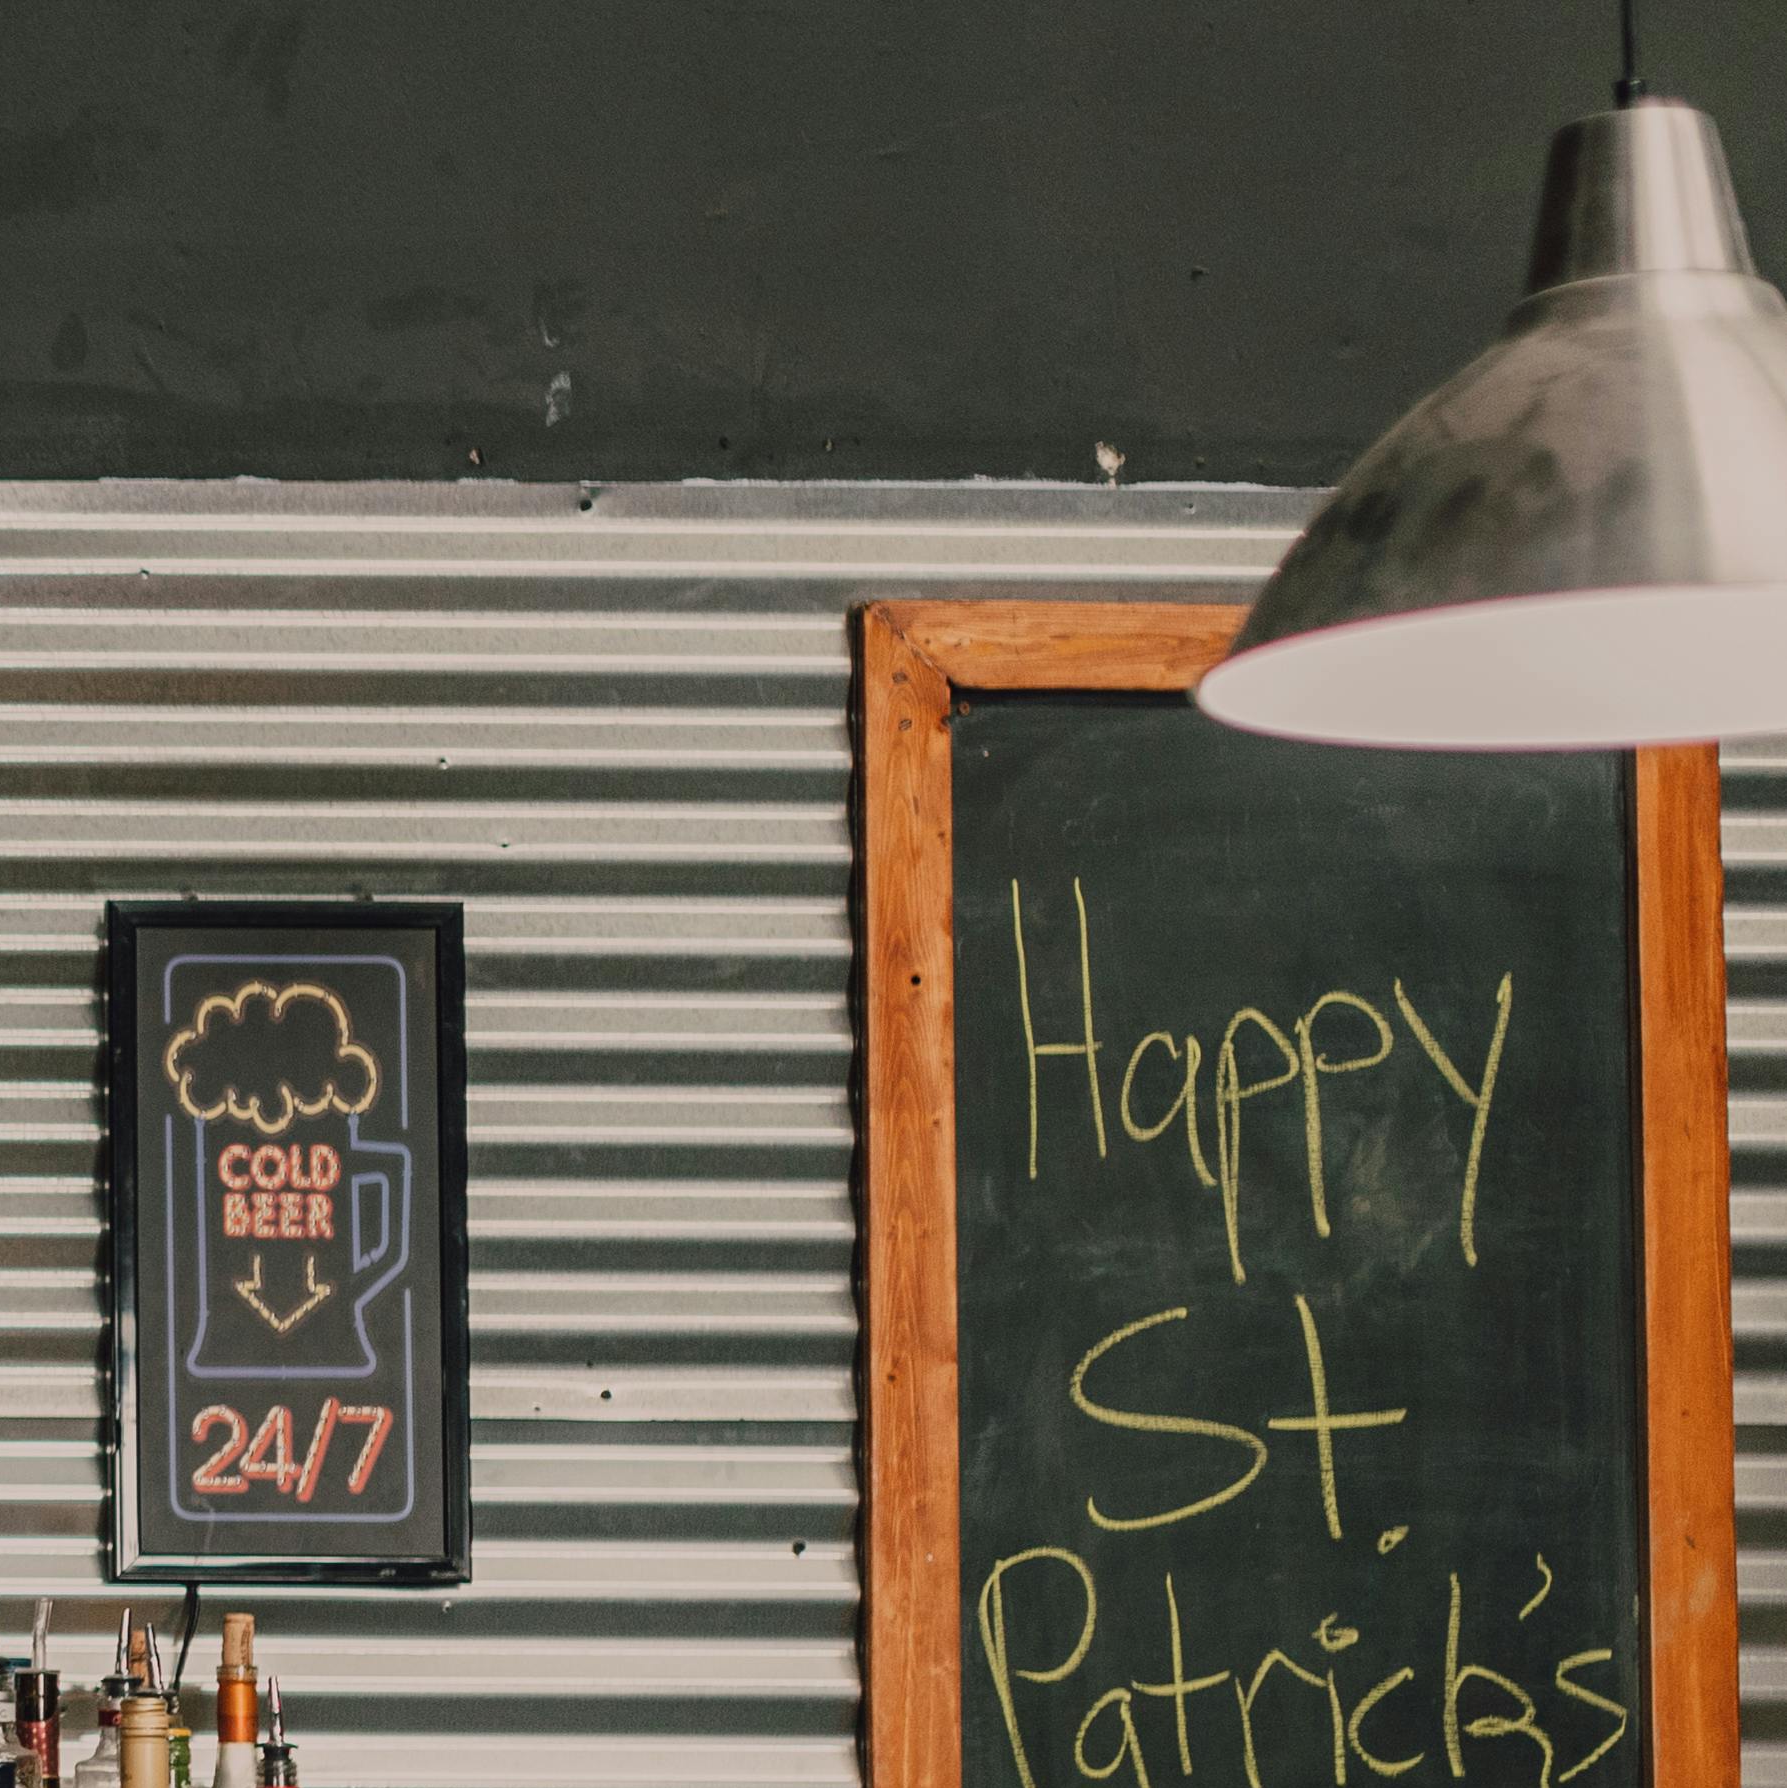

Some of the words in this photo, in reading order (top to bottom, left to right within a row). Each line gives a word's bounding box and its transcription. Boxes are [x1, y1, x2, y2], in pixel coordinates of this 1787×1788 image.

[1010, 876, 1513, 1285] Happy
[216, 1142, 343, 1192] COLD
[221, 1192, 336, 1241] BEER
[190, 1396, 394, 1502] 24/7
